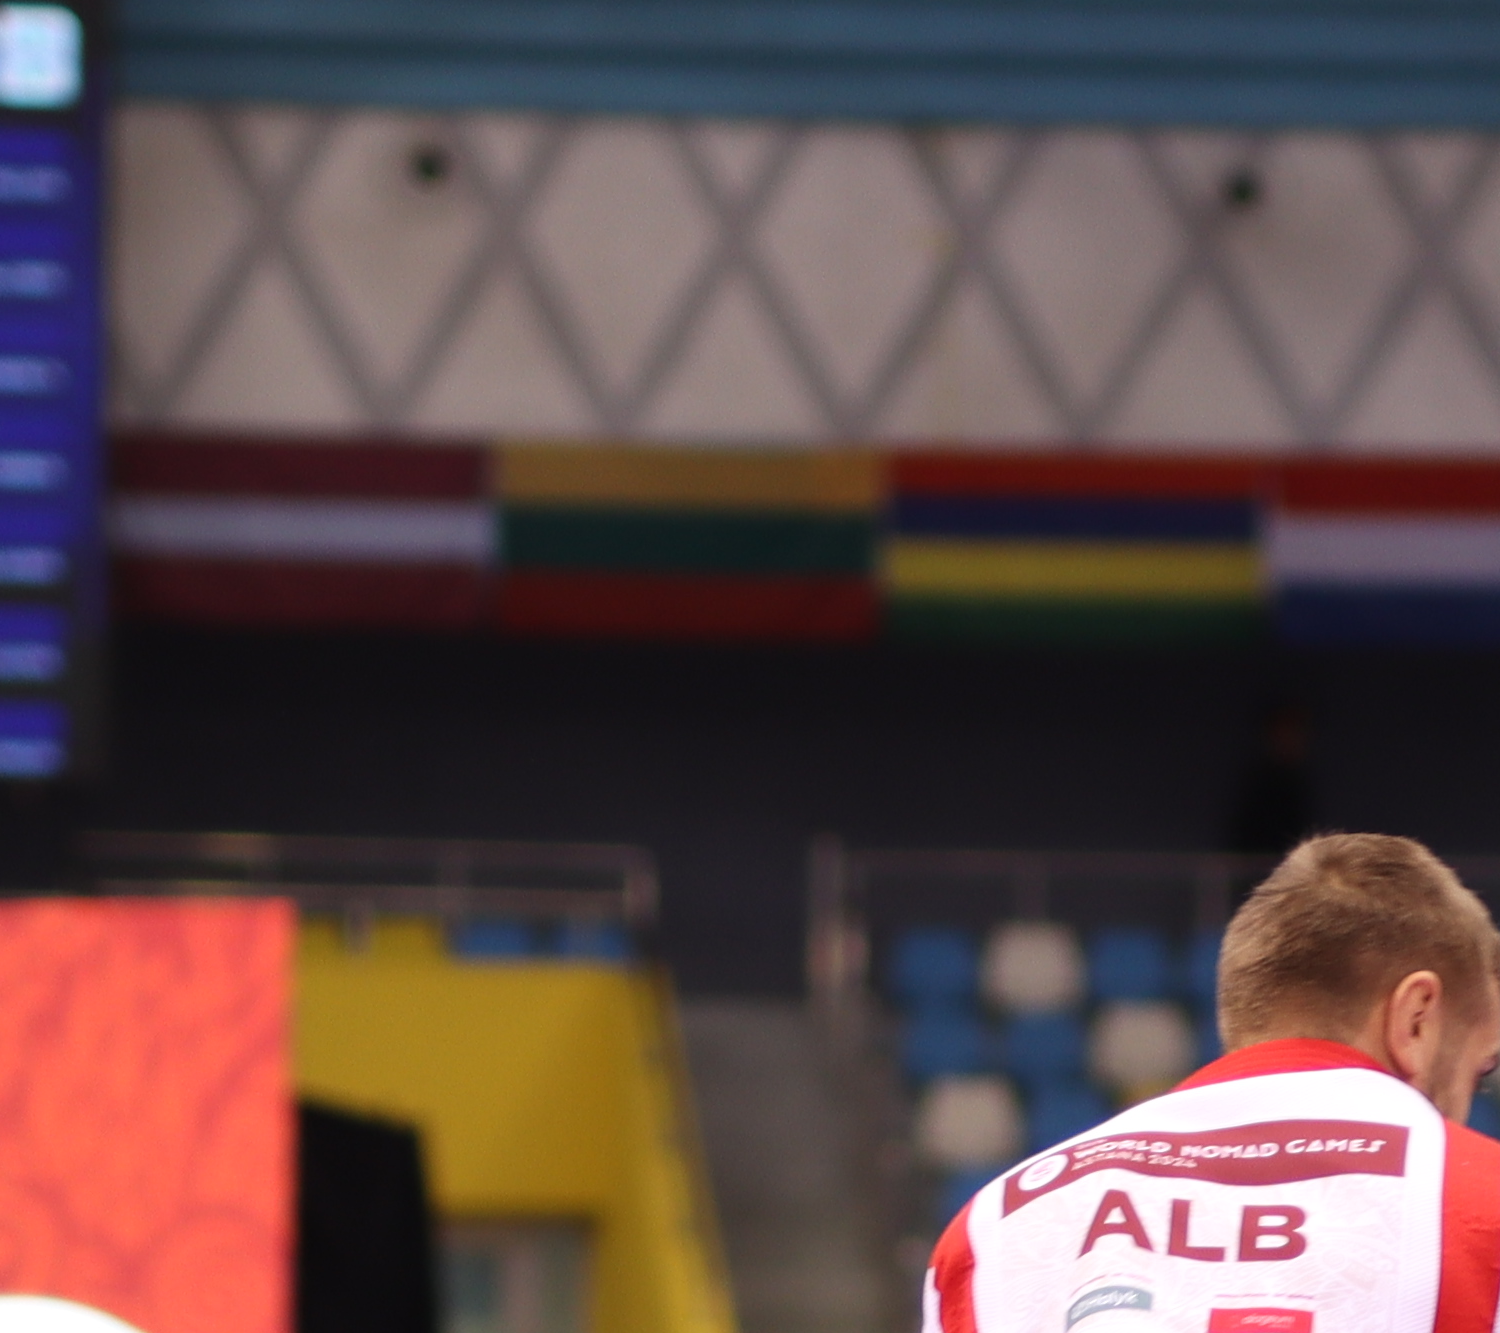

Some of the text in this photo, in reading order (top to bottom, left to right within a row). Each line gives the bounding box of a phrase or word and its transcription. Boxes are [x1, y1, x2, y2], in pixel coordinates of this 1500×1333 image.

[1073, 1140, 1172, 1159] WORLD
[1180, 1142, 1280, 1159] NOMAD
[1285, 1138, 1387, 1154] GAMES
[1077, 1188, 1308, 1262] ALB
